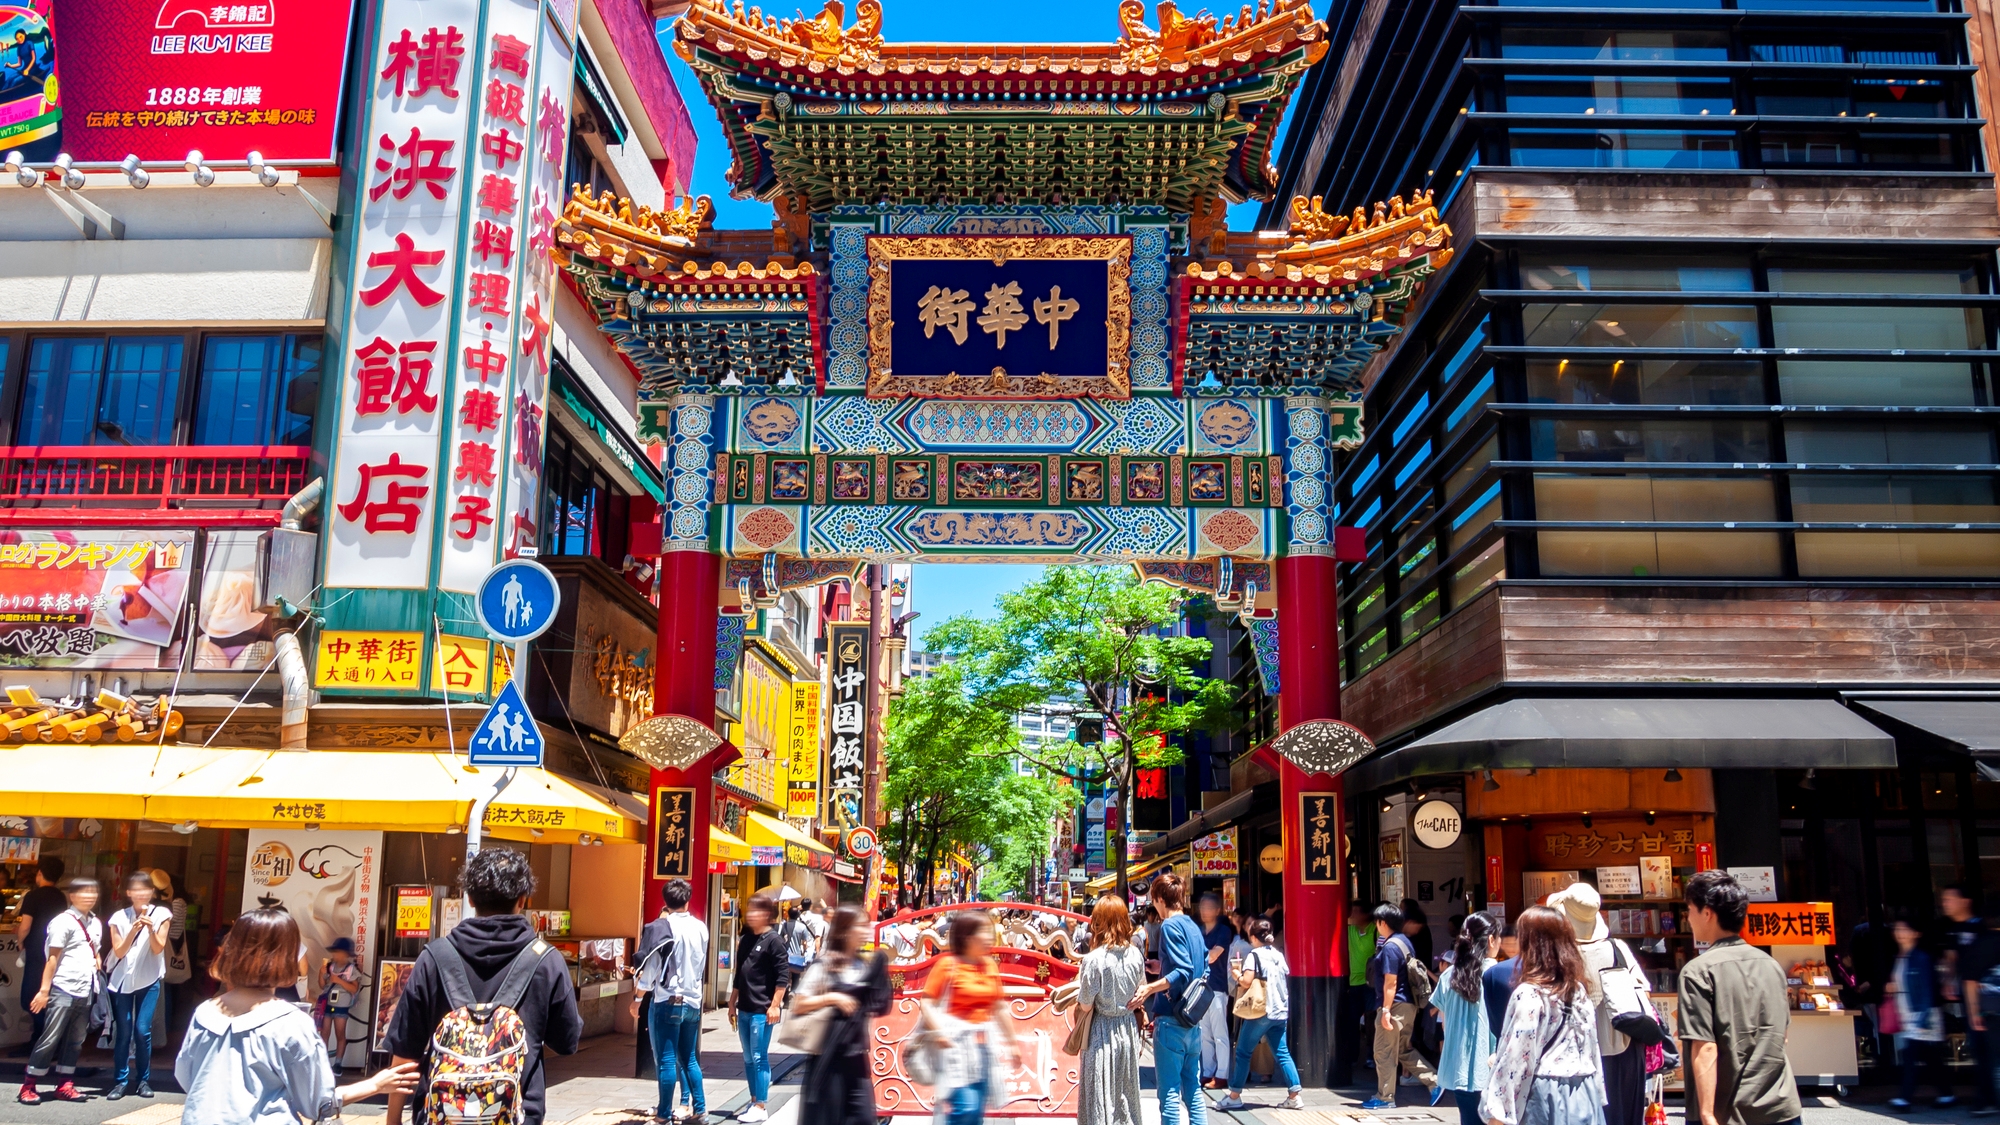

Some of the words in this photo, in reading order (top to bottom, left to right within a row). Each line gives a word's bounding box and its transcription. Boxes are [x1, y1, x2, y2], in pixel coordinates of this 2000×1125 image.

[209, 5, 267, 23] 李錦記
[152, 36, 184, 53] LEE
[190, 35, 232, 53] KUM
[236, 34, 271, 52] KEE
[145, 87, 262, 106] 1888年創業
[86, 108, 315, 127] 伝統を守り続けてきた本場の味
[337, 25, 466, 535] 横浜大飯店
[450, 33, 532, 540] 高級中華料理・中華菓子
[918, 280, 1080, 351] 中華街
[160, 551, 178, 567] 1位
[327, 637, 417, 664] 中華街
[443, 643, 478, 688] 入口
[325, 667, 414, 684] 大通り入口
[792, 687, 806, 775] 世界一の肉まん
[790, 791, 815, 802] 100円
[272, 802, 326, 820] 大粒甘栗
[1417, 819, 1433, 830] The
[1433, 817, 1458, 832] CAFE
[854, 836, 870, 849] 30
[1545, 829, 1695, 858] 聘珍大甘栗
[253, 846, 292, 877] 元祖
[361, 846, 373, 893] 中華街名物
[251, 868, 270, 876] Since
[253, 877, 269, 885] 1996
[400, 907, 428, 919] 20%
[1747, 912, 1832, 936] 聘珍大甘栗
